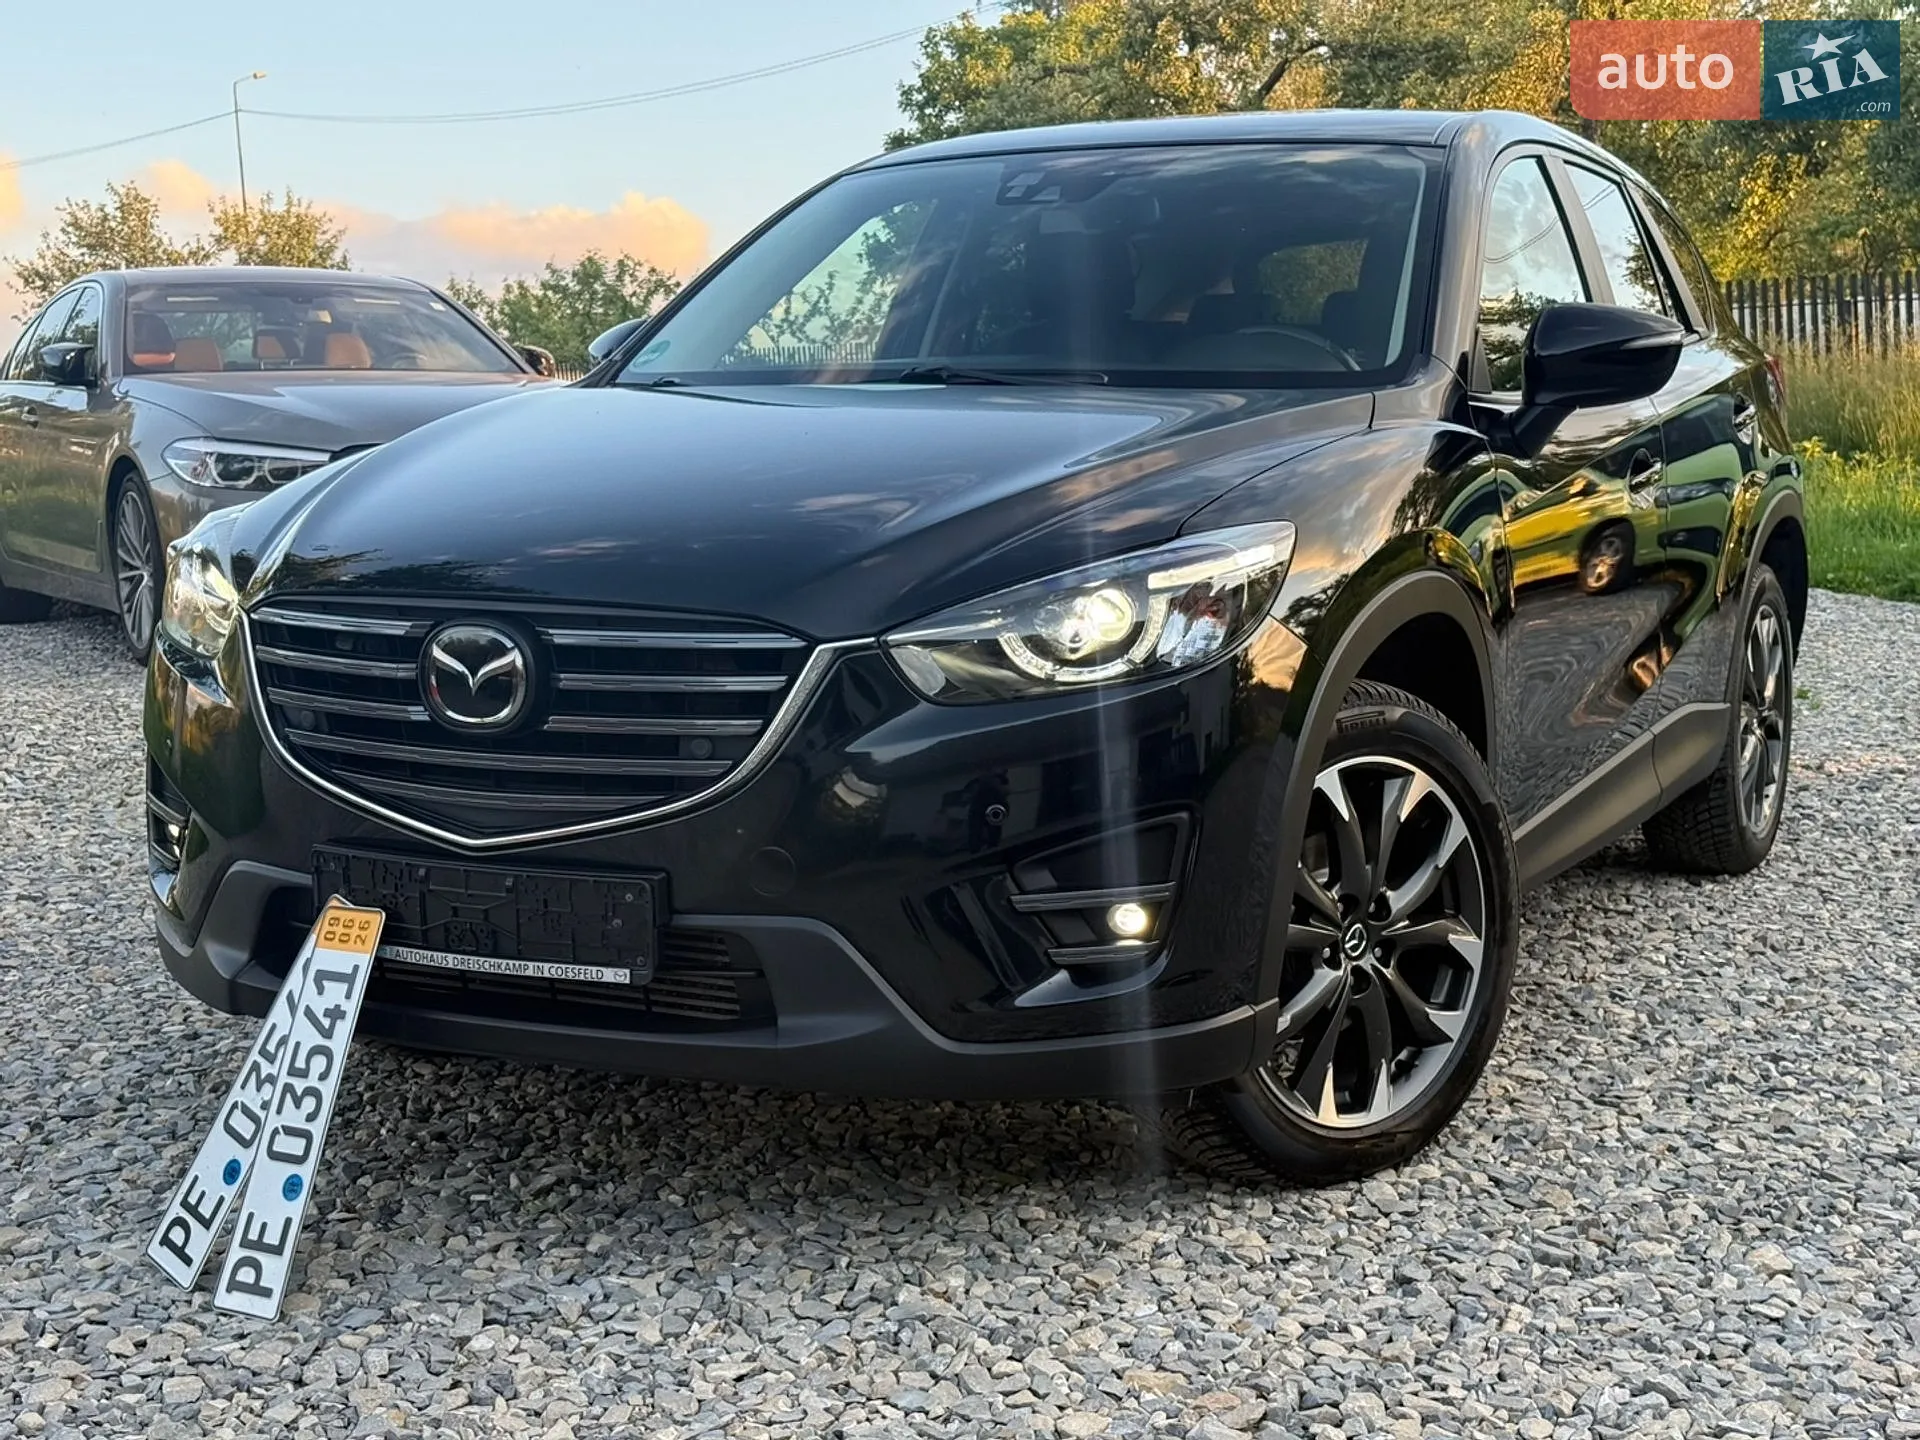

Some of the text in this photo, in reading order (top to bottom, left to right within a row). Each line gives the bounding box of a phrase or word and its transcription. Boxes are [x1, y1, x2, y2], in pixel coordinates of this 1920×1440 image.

[1335, 710, 1386, 734] PIRELLI
[324, 916, 340, 942] 09
[338, 918, 355, 944] 06
[353, 920, 371, 946] 26
[394, 948, 450, 967] AUTOHAUS
[452, 955, 529, 975] DREISCHKAMP
[532, 964, 545, 976] IN
[547, 965, 605, 981] COESFELD
[226, 964, 360, 1299] PE 03541
[159, 1174, 225, 1267] PE
